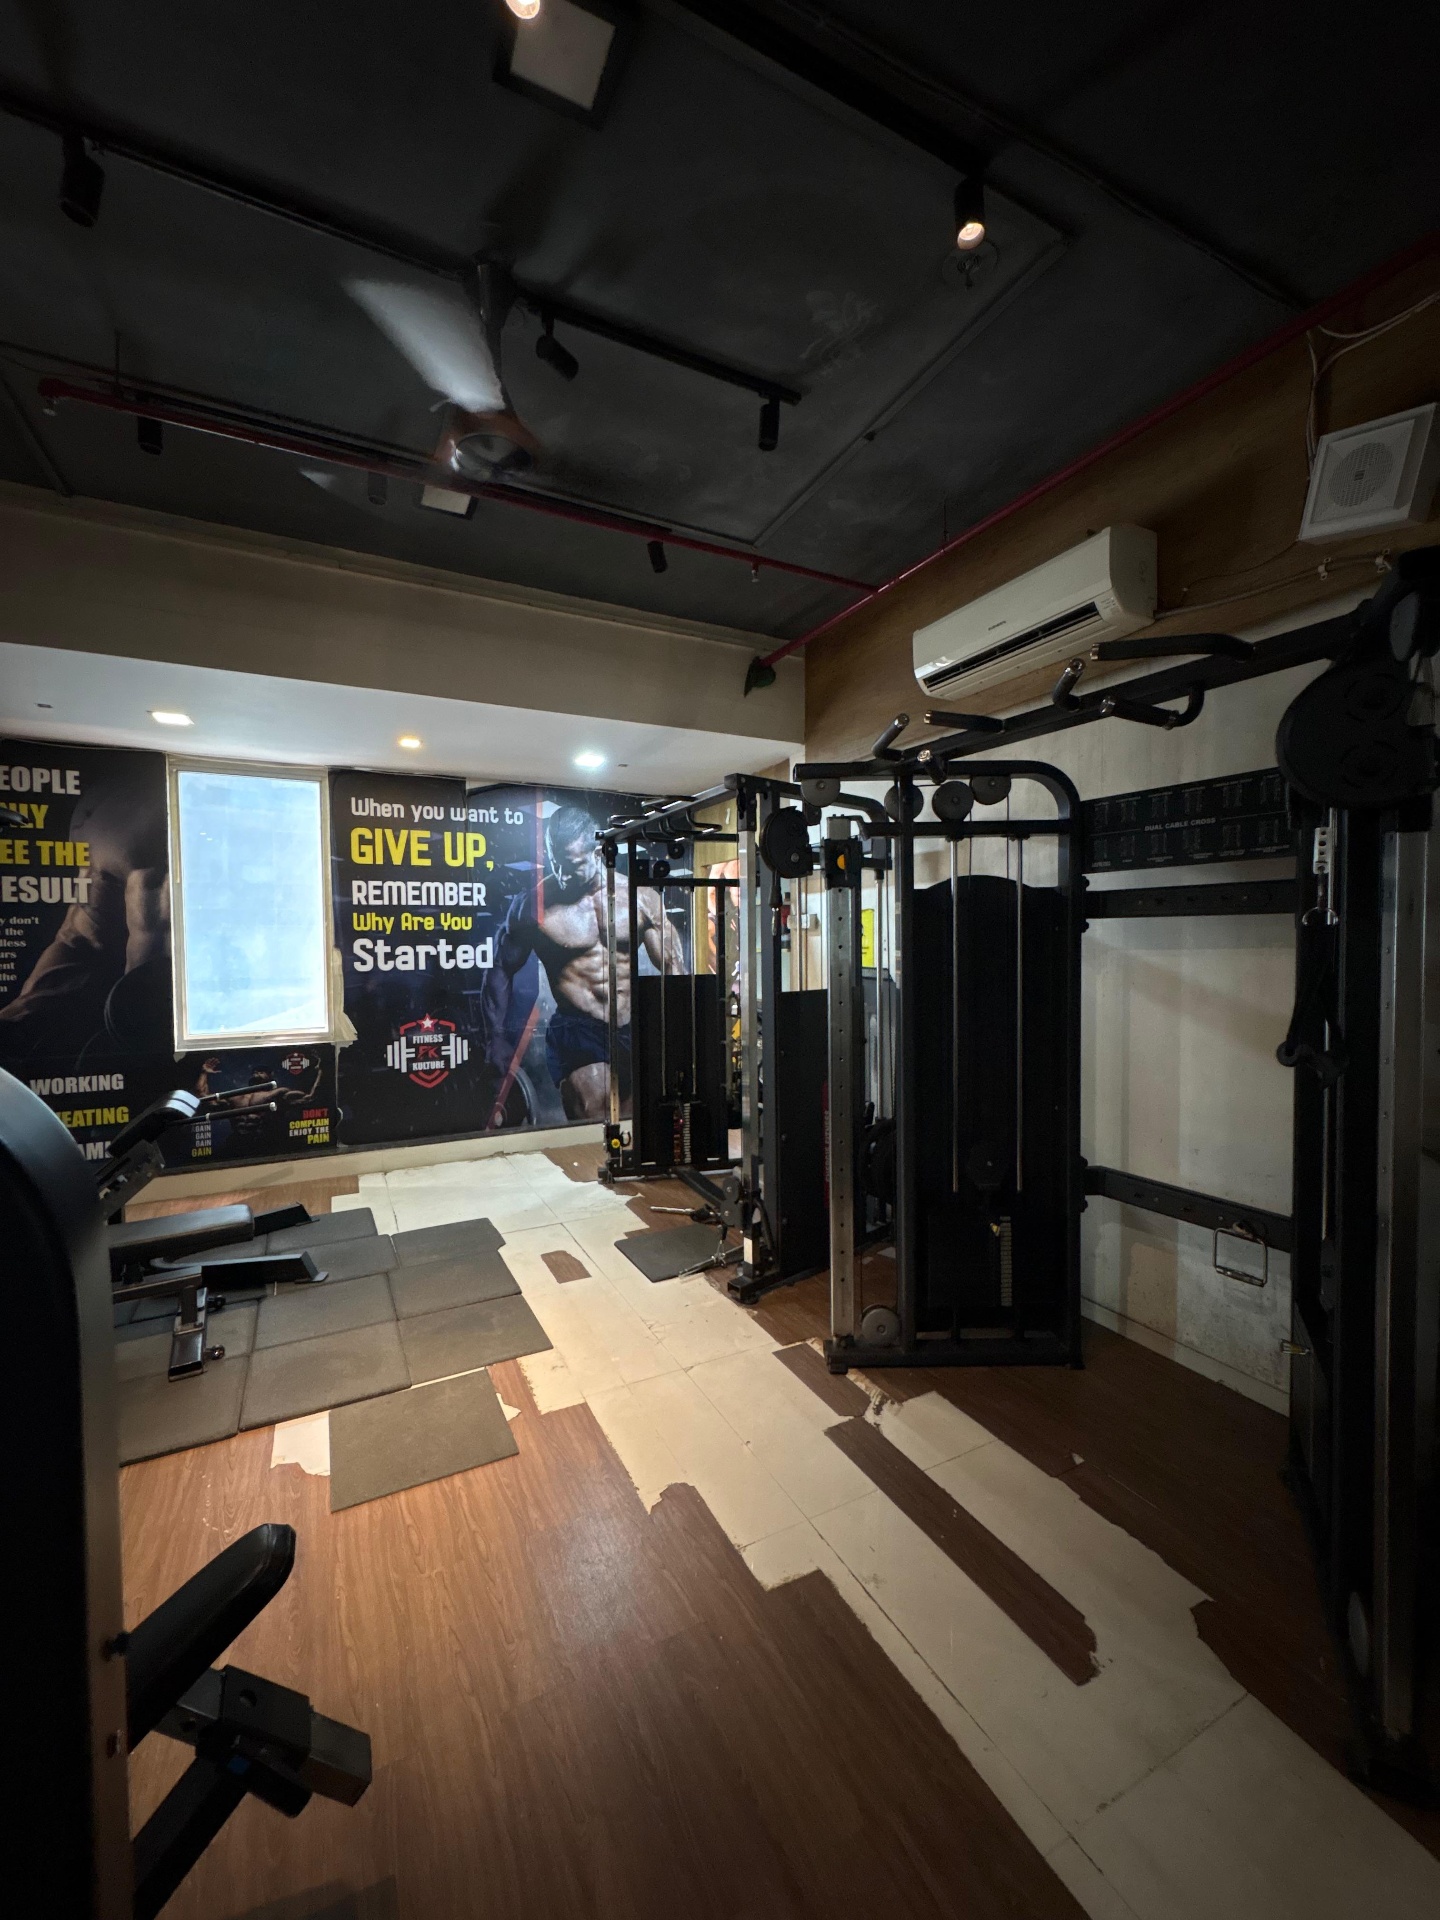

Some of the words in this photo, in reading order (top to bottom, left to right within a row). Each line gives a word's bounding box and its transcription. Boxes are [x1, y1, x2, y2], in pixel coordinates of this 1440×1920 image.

[351, 796, 405, 818] When
[412, 804, 445, 822] you
[450, 805, 499, 824] want
[504, 807, 524, 825] to
[36, 840, 90, 867] THE
[350, 828, 431, 866] GIVE
[444, 832, 494, 871] UP,
[352, 880, 486, 906] REMEMBER
[9, 916, 39, 925] don't
[353, 912, 394, 934] Why
[401, 912, 434, 931] Are
[441, 913, 472, 930] You
[5, 928, 24, 936] the
[353, 937, 494, 972] Started
[412, 1033, 444, 1044] FITNESS
[412, 1060, 445, 1071] KULTURE
[30, 1073, 124, 1095] WORKING
[56, 1106, 129, 1128] EATING
[289, 1118, 330, 1129] COMPLAIN
[289, 1127, 312, 1137] ENJOY
[315, 1126, 330, 1134] THE
[307, 1133, 330, 1145] PAIN
[191, 1147, 212, 1157] GAIN
